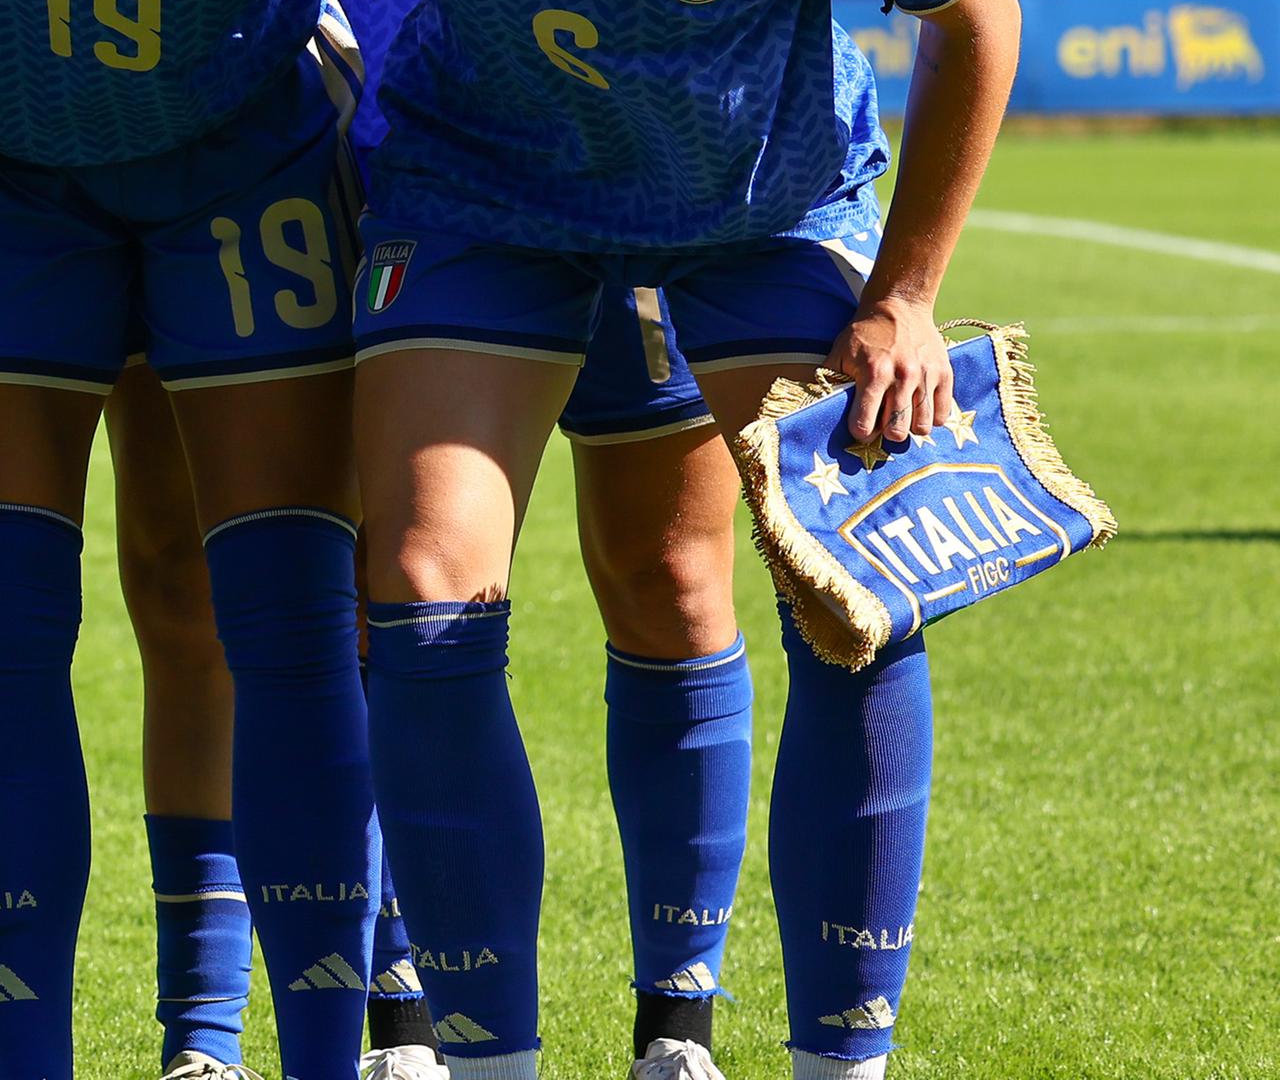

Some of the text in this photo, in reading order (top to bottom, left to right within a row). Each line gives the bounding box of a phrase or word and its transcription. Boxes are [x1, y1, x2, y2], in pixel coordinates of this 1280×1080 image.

[1057, 10, 1164, 79] eni
[210, 198, 337, 337] 19
[374, 245, 410, 261] ITALIA
[866, 486, 1041, 584] ITALIA
[968, 557, 1011, 595] FIGC
[261, 882, 368, 903] ITALIA
[411, 943, 498, 971] TALIA
